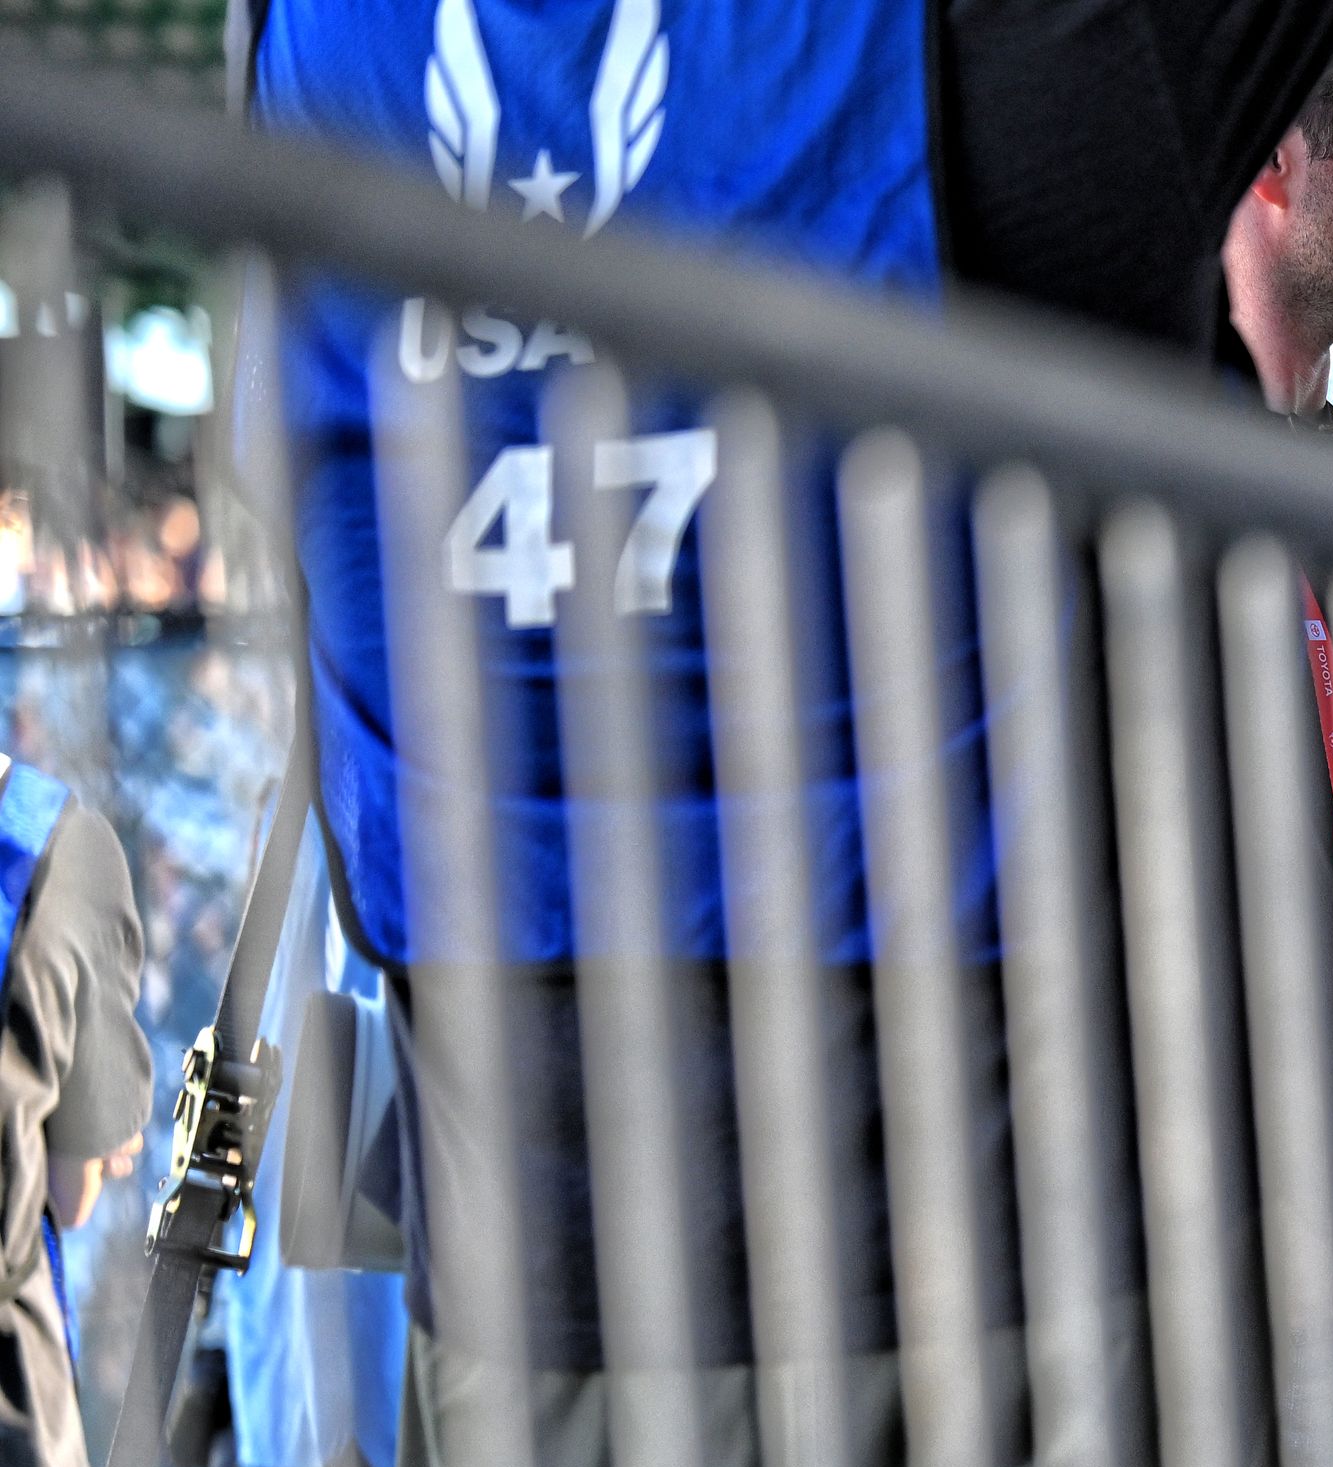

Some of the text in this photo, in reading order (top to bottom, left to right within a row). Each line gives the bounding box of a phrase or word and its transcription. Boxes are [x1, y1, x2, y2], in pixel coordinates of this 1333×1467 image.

[400, 297, 596, 384] USA
[443, 428, 718, 631] 47
[1316, 644, 1333, 697] TOYOTA
